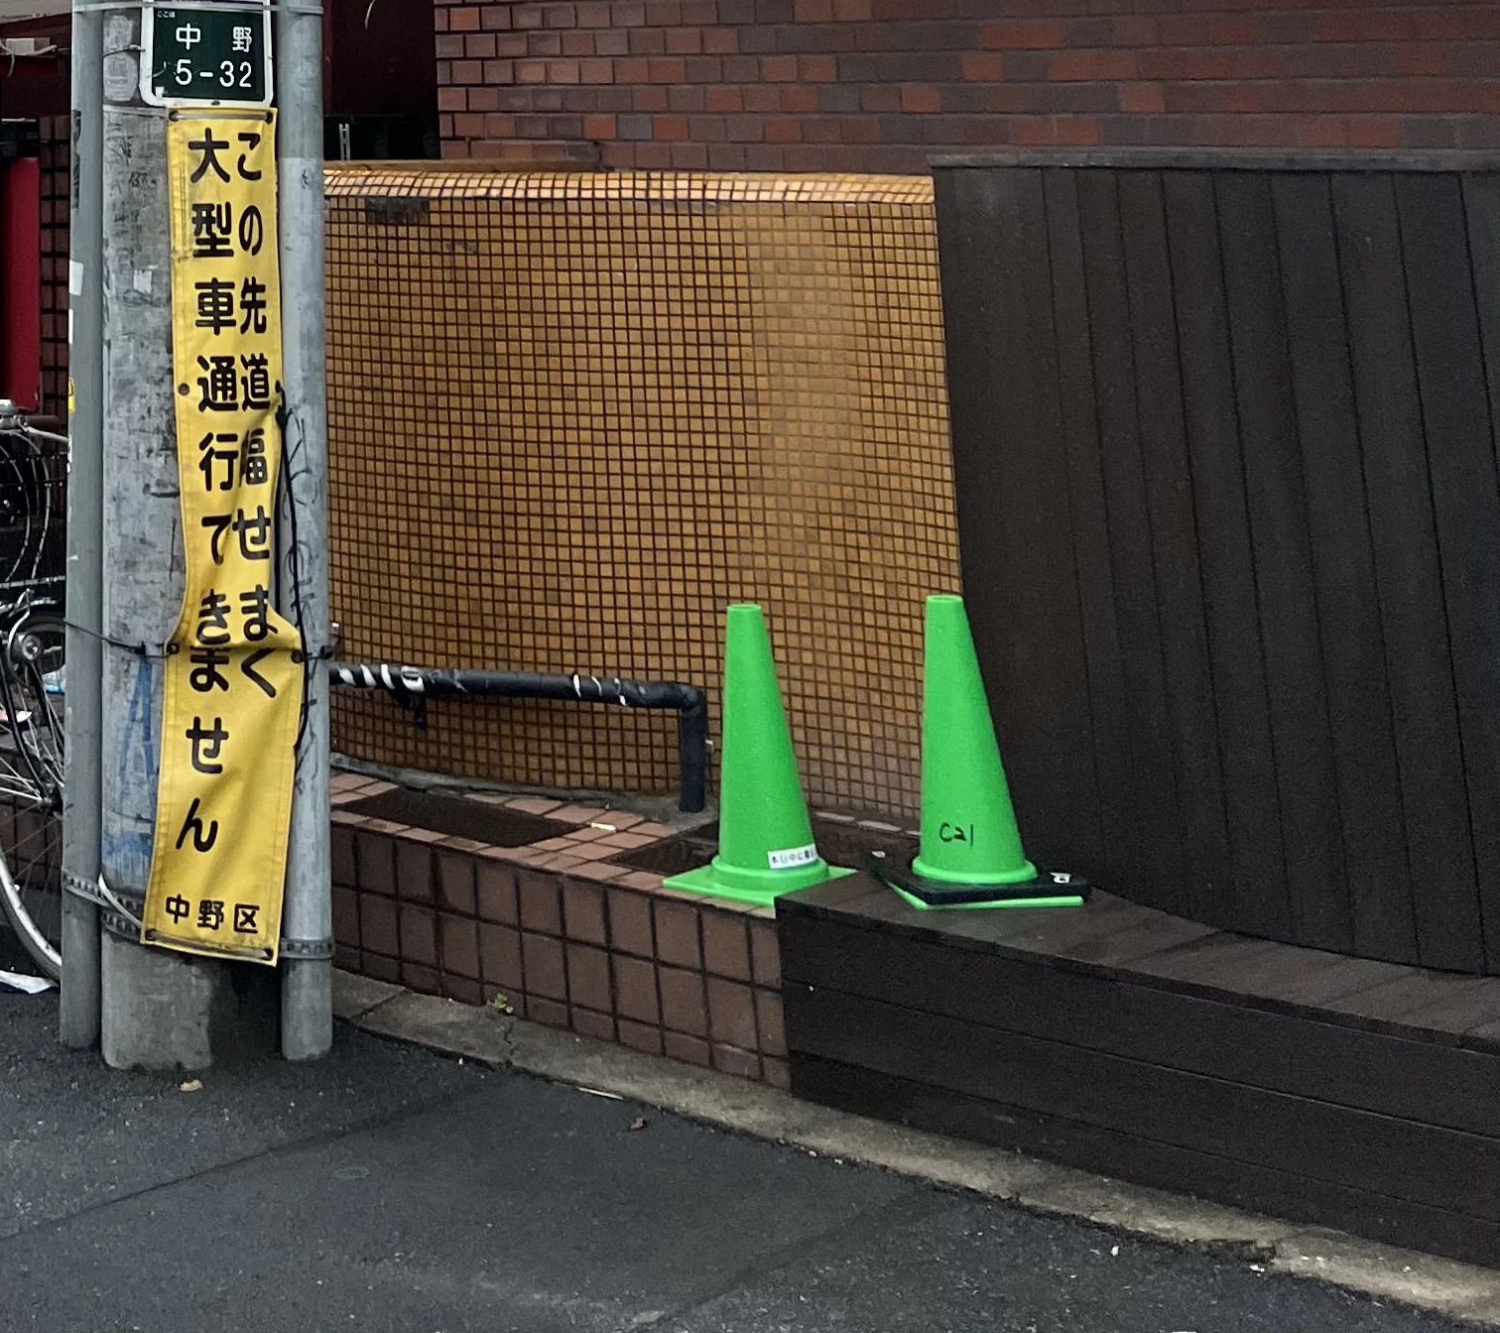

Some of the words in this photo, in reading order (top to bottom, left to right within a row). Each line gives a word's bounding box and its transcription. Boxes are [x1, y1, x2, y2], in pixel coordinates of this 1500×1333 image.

[175, 59, 252, 88] 5-32
[176, 128, 238, 853] 大型車通行できません
[232, 133, 277, 697] この先道幅せまく
[165, 893, 260, 934] 中野区
